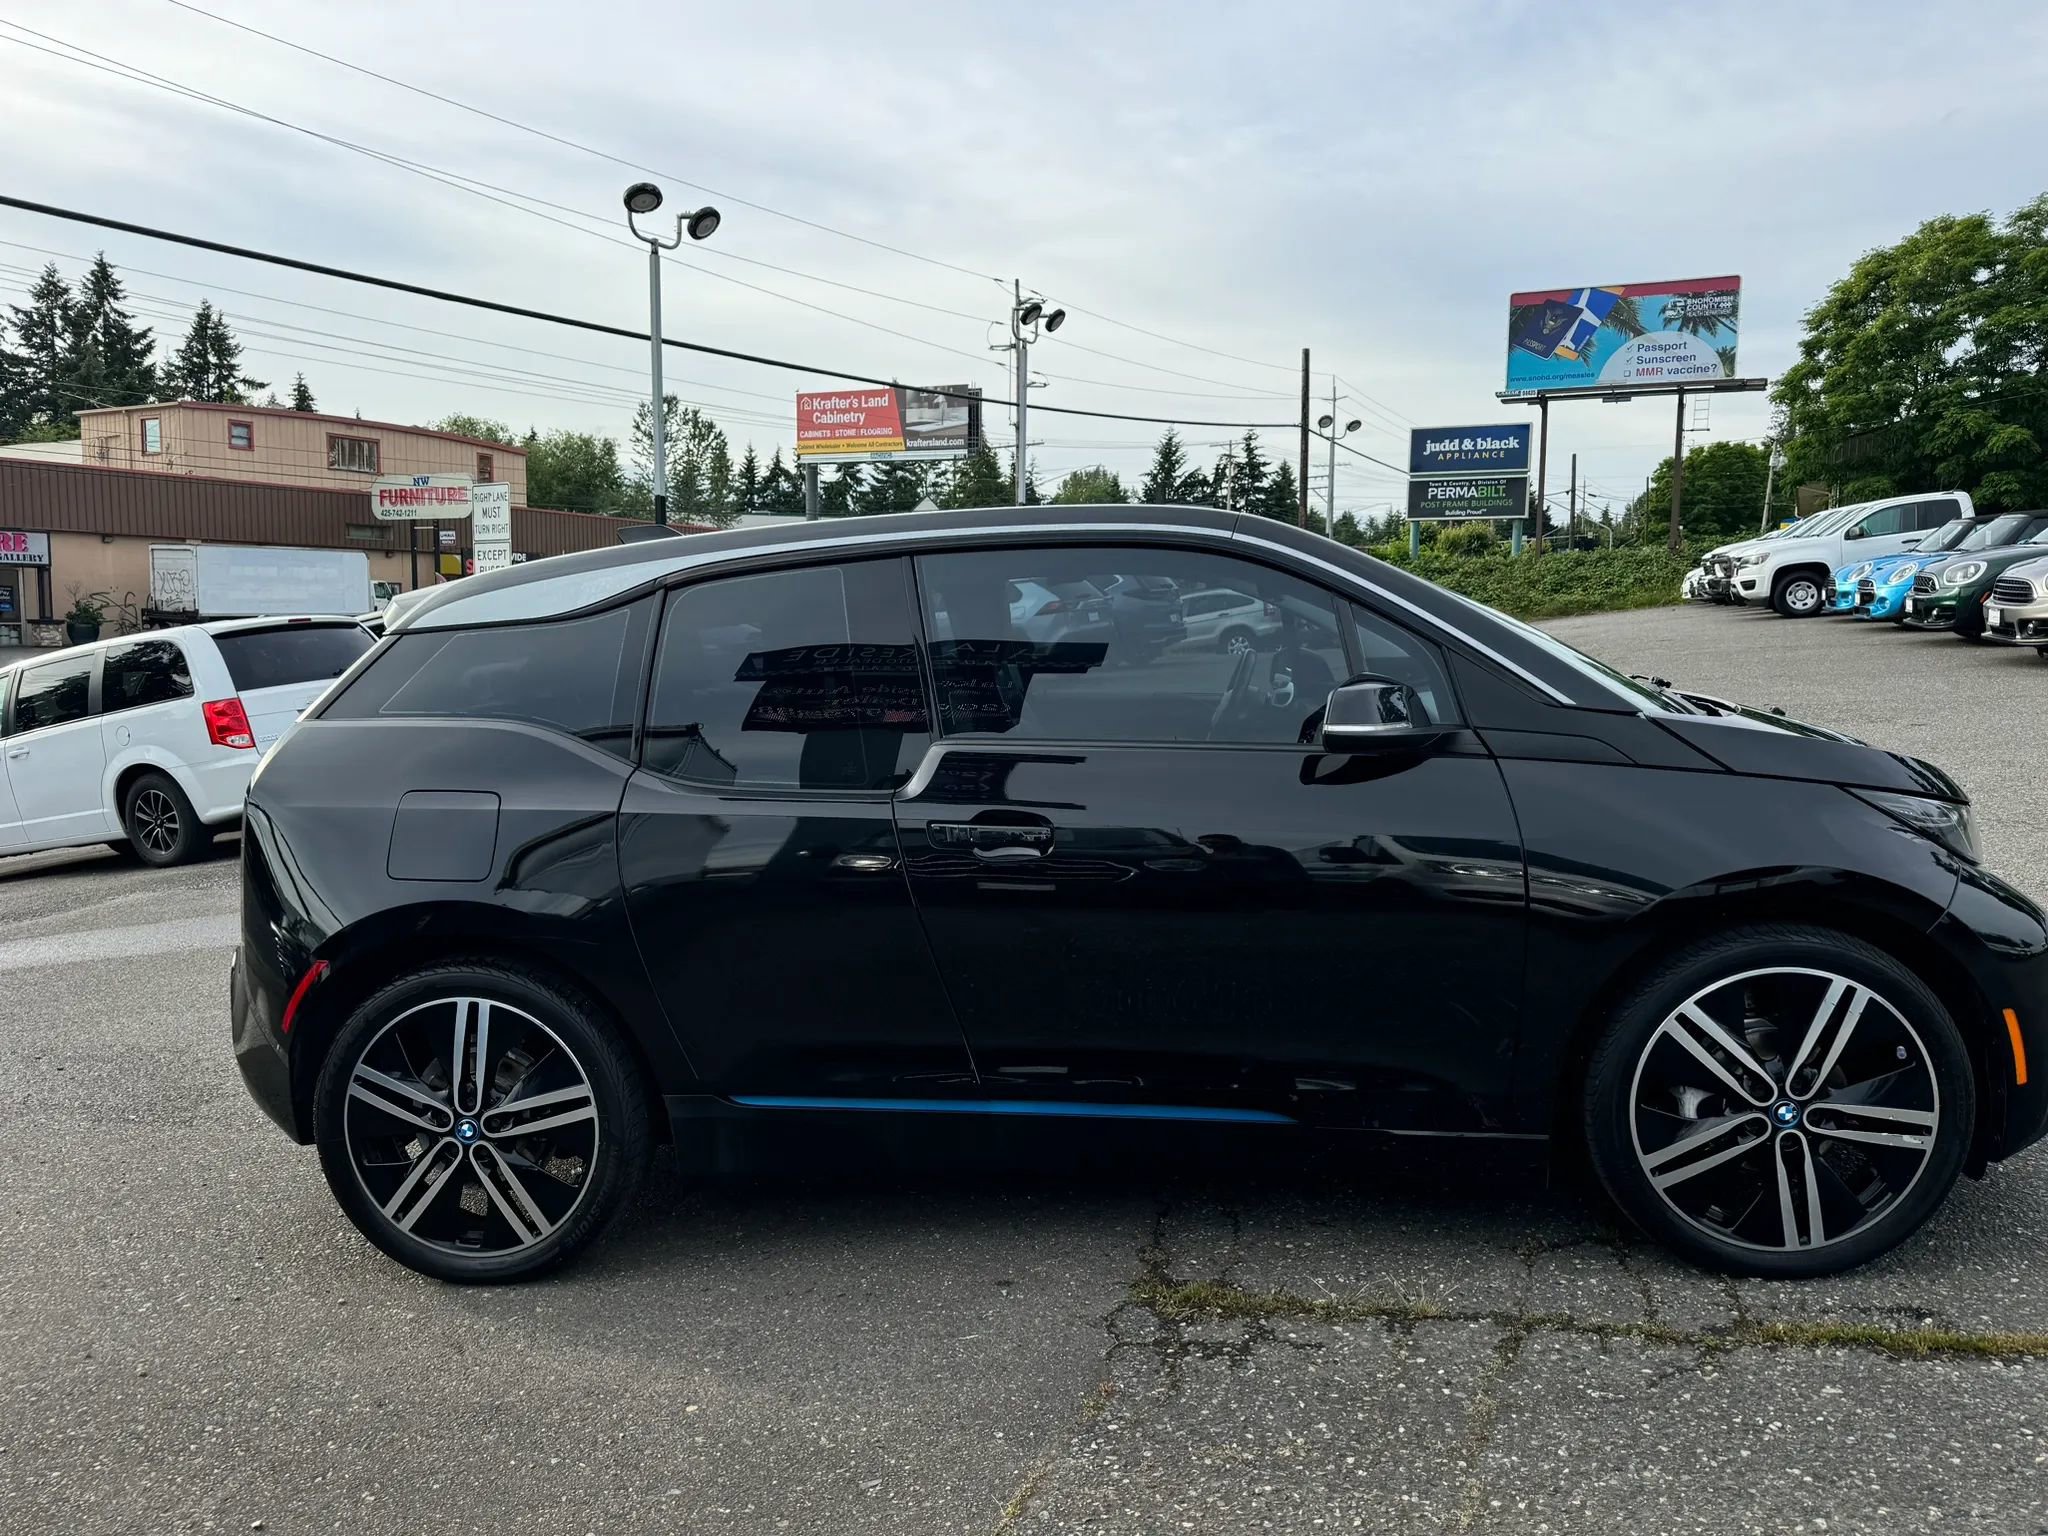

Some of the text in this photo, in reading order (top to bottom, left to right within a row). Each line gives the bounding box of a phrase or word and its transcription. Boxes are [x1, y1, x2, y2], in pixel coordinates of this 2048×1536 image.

[1686, 295, 1734, 305] SNOHOMISH
[1686, 303, 1718, 311] COUNTY
[1637, 341, 1688, 354] Passport
[1636, 354, 1696, 365] Sunscreen
[1636, 364, 1718, 378] MMR vaccine?
[812, 393, 889, 410] Krafter's Land
[813, 411, 866, 426] Cabinetry
[800, 427, 893, 438] CABINETS STONE FLOORING
[906, 437, 965, 449] kraftersland.com
[1423, 435, 1520, 456] judd & black
[1437, 450, 1505, 461] APPLIANCE
[413, 476, 430, 487] NW
[379, 486, 470, 507] FURNITURE
[474, 490, 508, 503] RIGHT LANE
[1420, 498, 1513, 509] POST FRAME BUILDINGS
[482, 506, 501, 518] MUST
[1445, 508, 1466, 517] Building
[475, 523, 508, 535] TURN RIGHT
[477, 549, 507, 560] EXCEPT
